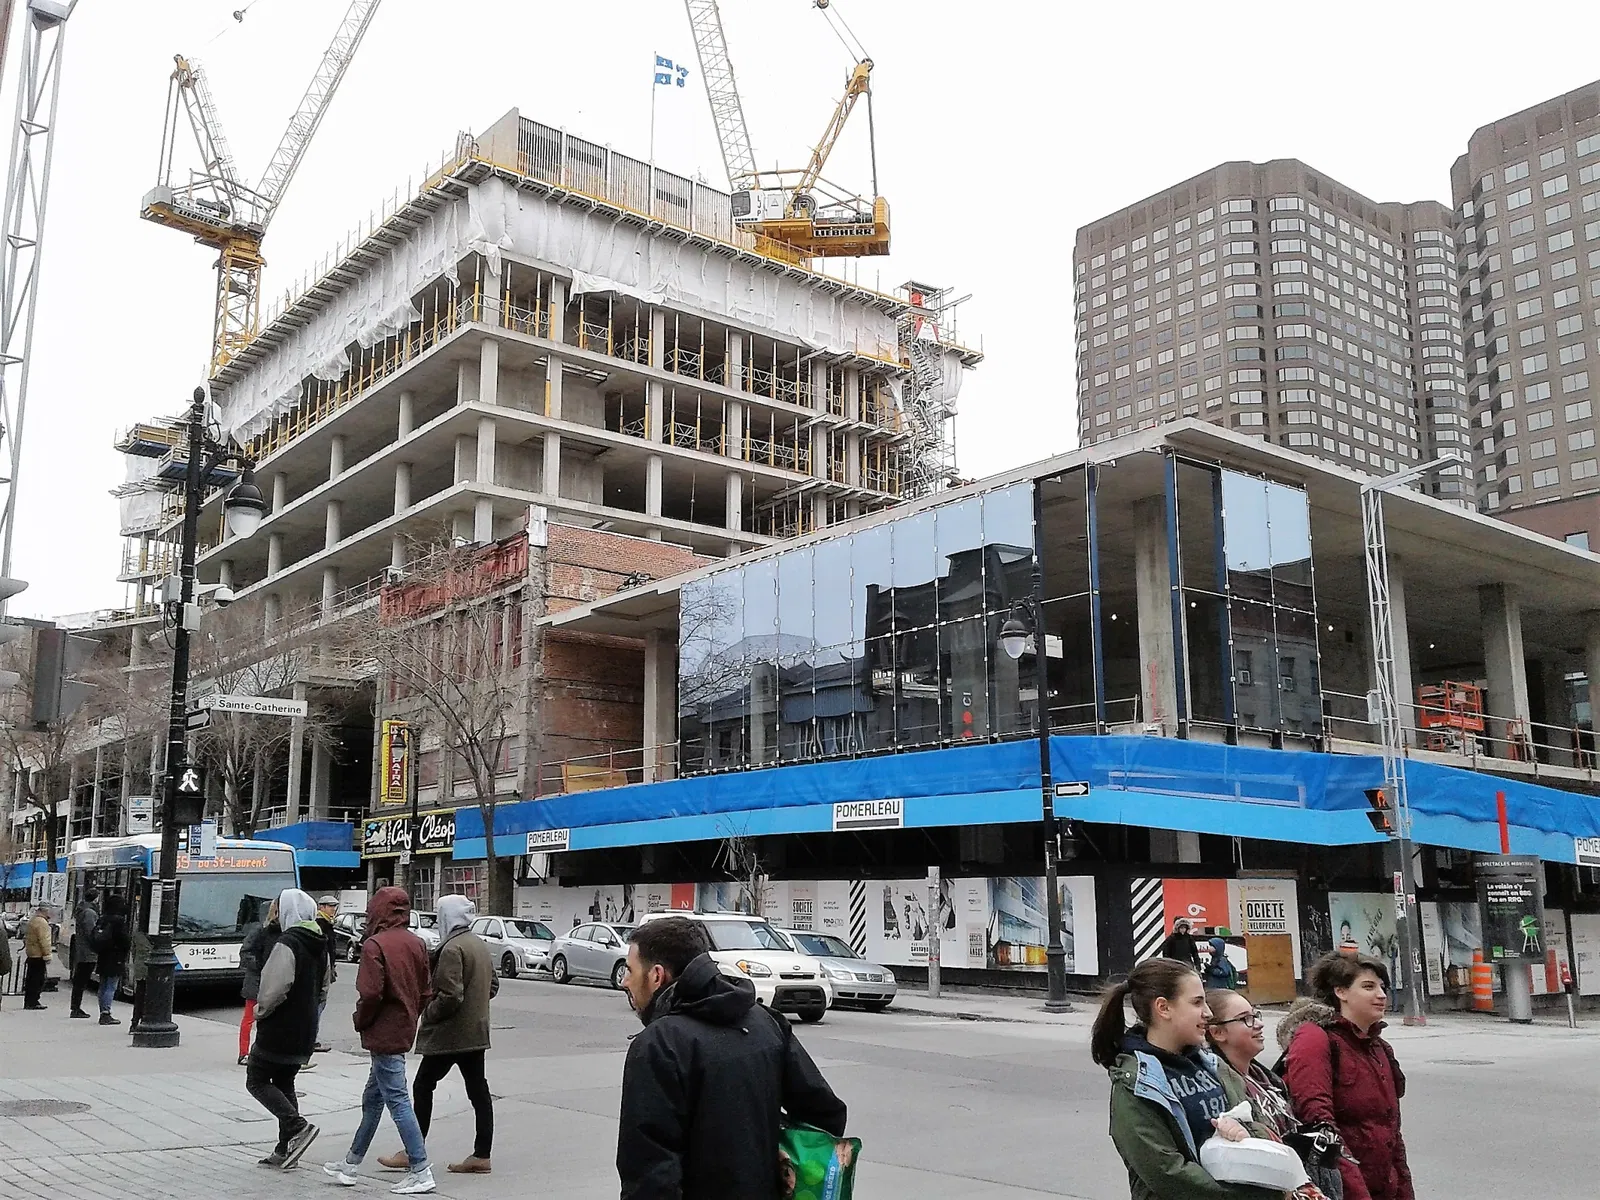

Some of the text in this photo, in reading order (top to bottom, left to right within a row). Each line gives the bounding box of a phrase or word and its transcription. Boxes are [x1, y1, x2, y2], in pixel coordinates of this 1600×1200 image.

[815, 228, 872, 237] LIEBHERR
[218, 699, 302, 714] Sainte-Catherine
[836, 800, 901, 818] POMERLEAU
[391, 819, 413, 850] Caf
[420, 815, 456, 845] Cléop
[528, 830, 568, 844] POMERLEAU
[1577, 837, 1600, 853] POME
[189, 948, 217, 957] 31-142
